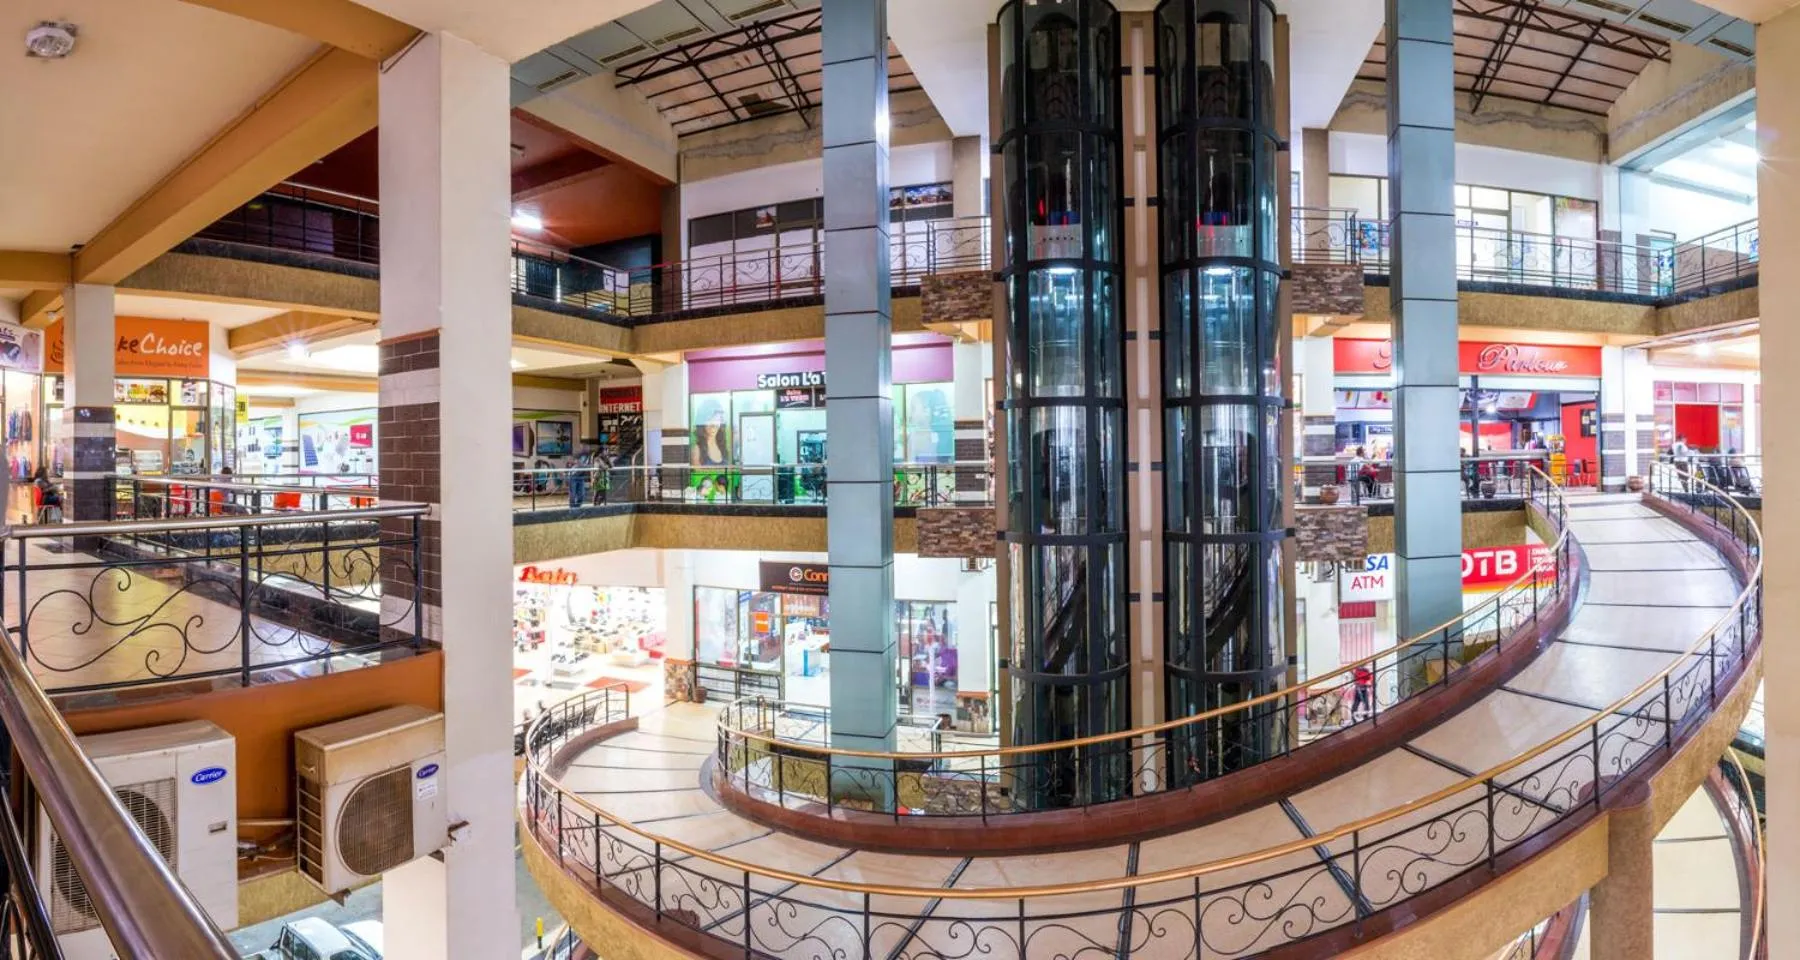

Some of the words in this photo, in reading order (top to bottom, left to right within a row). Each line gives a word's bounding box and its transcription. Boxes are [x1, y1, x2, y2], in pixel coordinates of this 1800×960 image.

[758, 374, 800, 388] Salon
[600, 401, 642, 413] INTERNET
[1366, 555, 1389, 571] SA
[1351, 575, 1384, 590] ATM
[195, 770, 223, 782] Carrier
